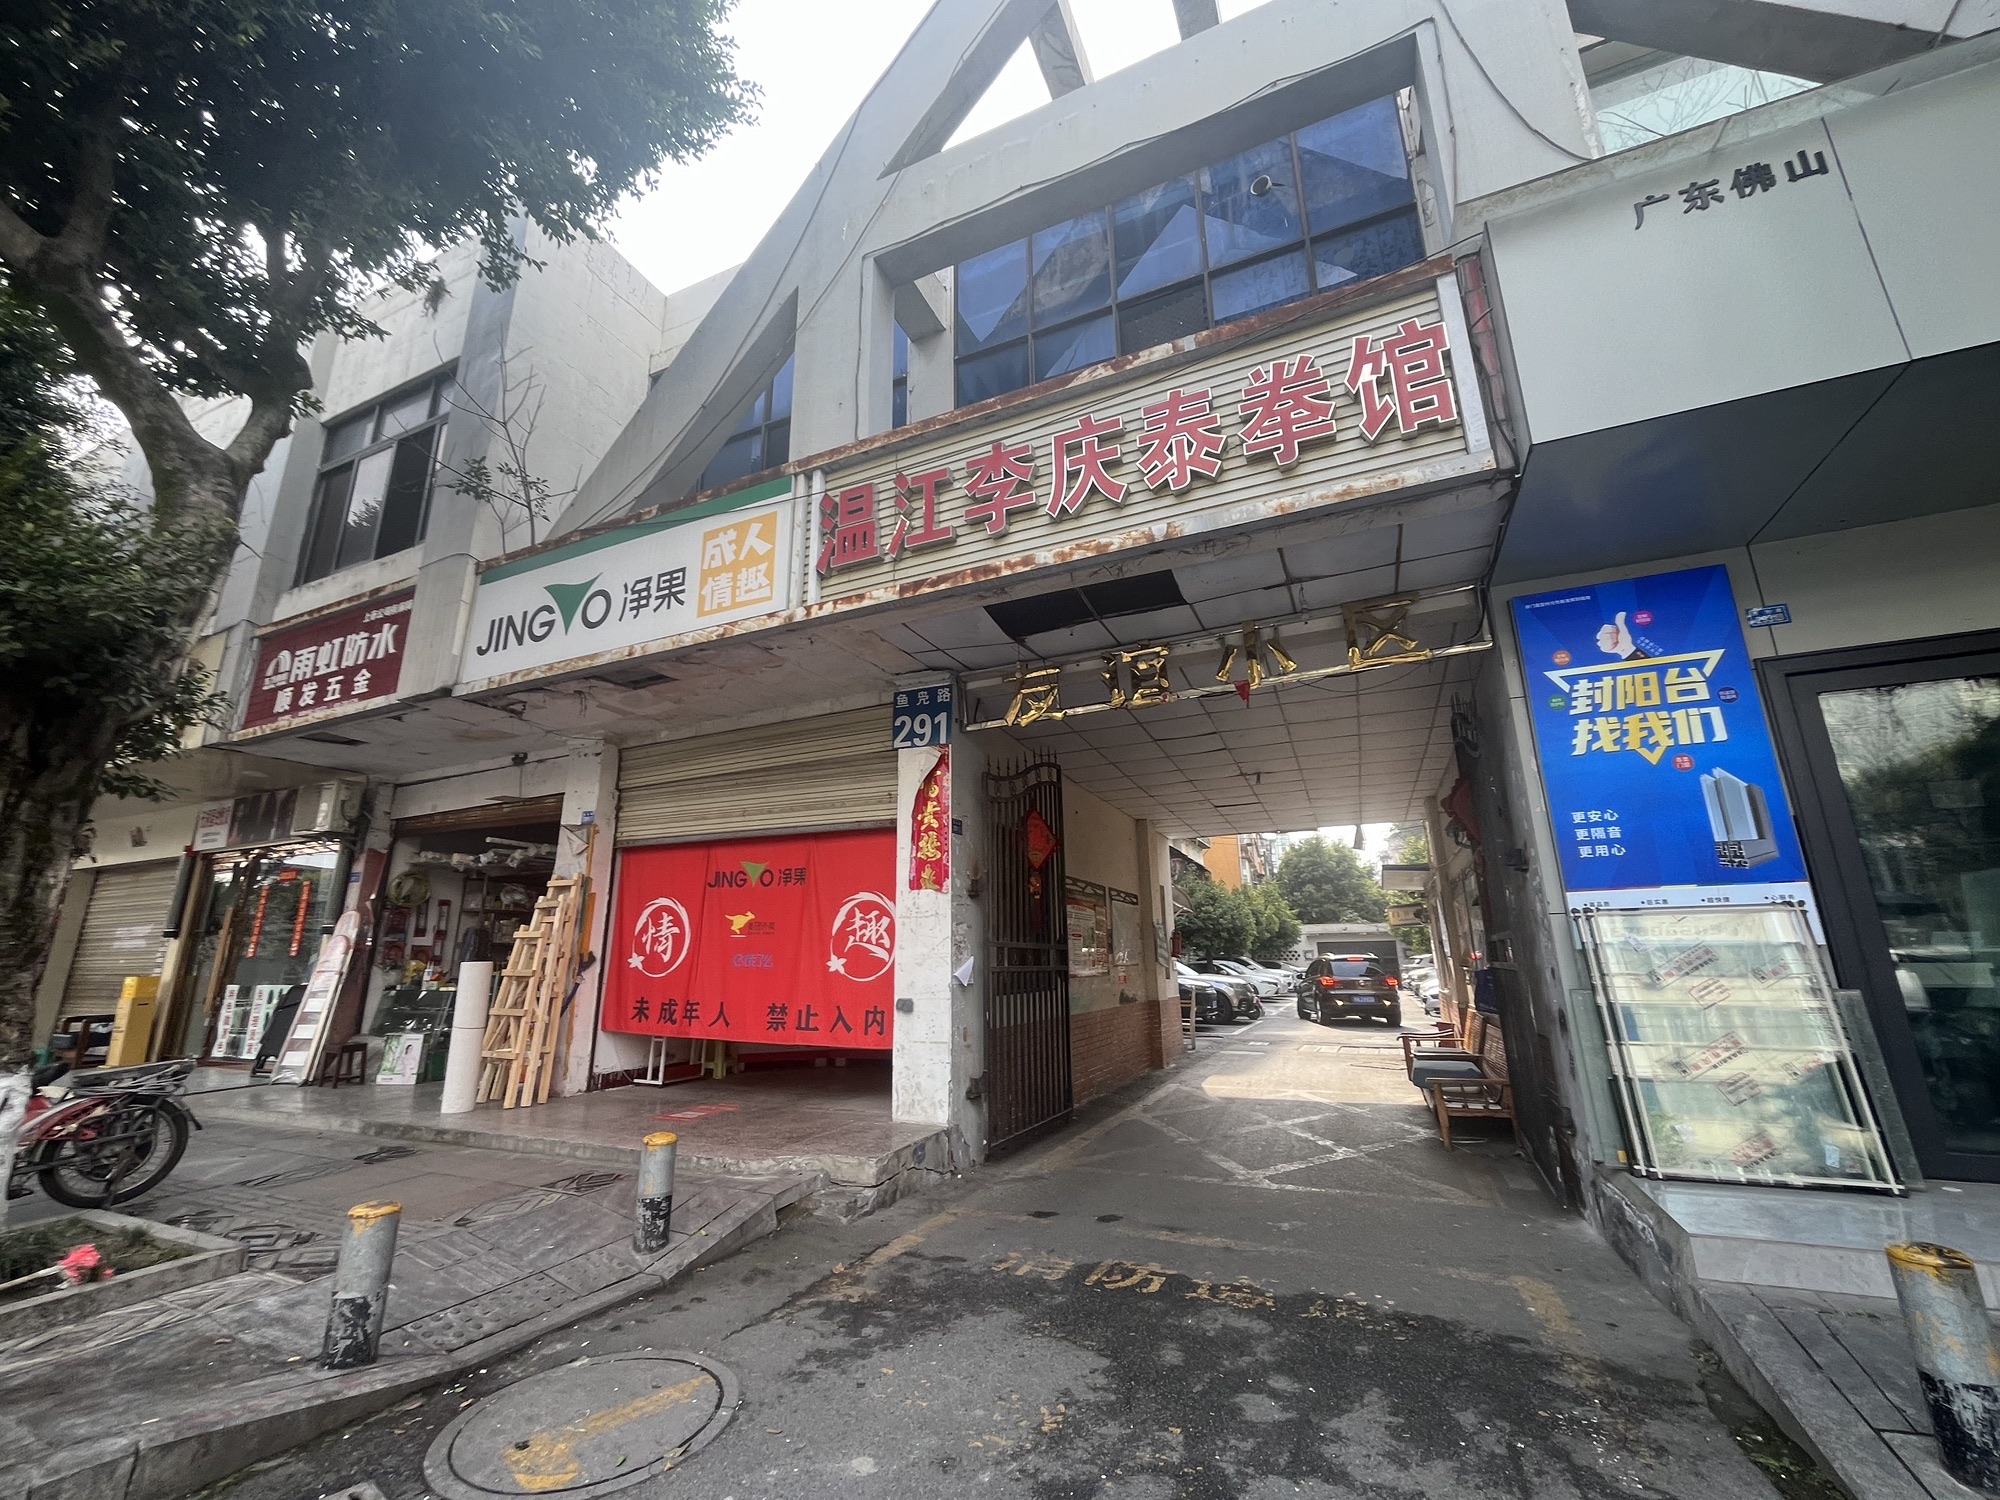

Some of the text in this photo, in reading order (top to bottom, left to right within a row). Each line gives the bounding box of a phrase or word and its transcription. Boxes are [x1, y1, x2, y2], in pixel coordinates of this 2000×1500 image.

[1633, 149, 1829, 231] 广东佛山
[816, 317, 1459, 577] 温江李庆泰拳馆
[702, 520, 774, 571] 成人
[618, 566, 688, 623] 净果
[701, 565, 772, 612] 情趣
[895, 687, 951, 709] 鱼凫路
[1568, 667, 1711, 716] 封阳台
[893, 711, 948, 749] 291
[1570, 706, 1729, 757] 找我们
[1570, 808, 1620, 824] 更安心
[1574, 825, 1622, 841] 更隔音
[1577, 843, 1627, 859] 更用心
[777, 867, 808, 887] 净果
[641, 911, 681, 964] 情
[843, 906, 892, 964] 趣
[630, 996, 887, 1037] 未成年人 禁止入内
